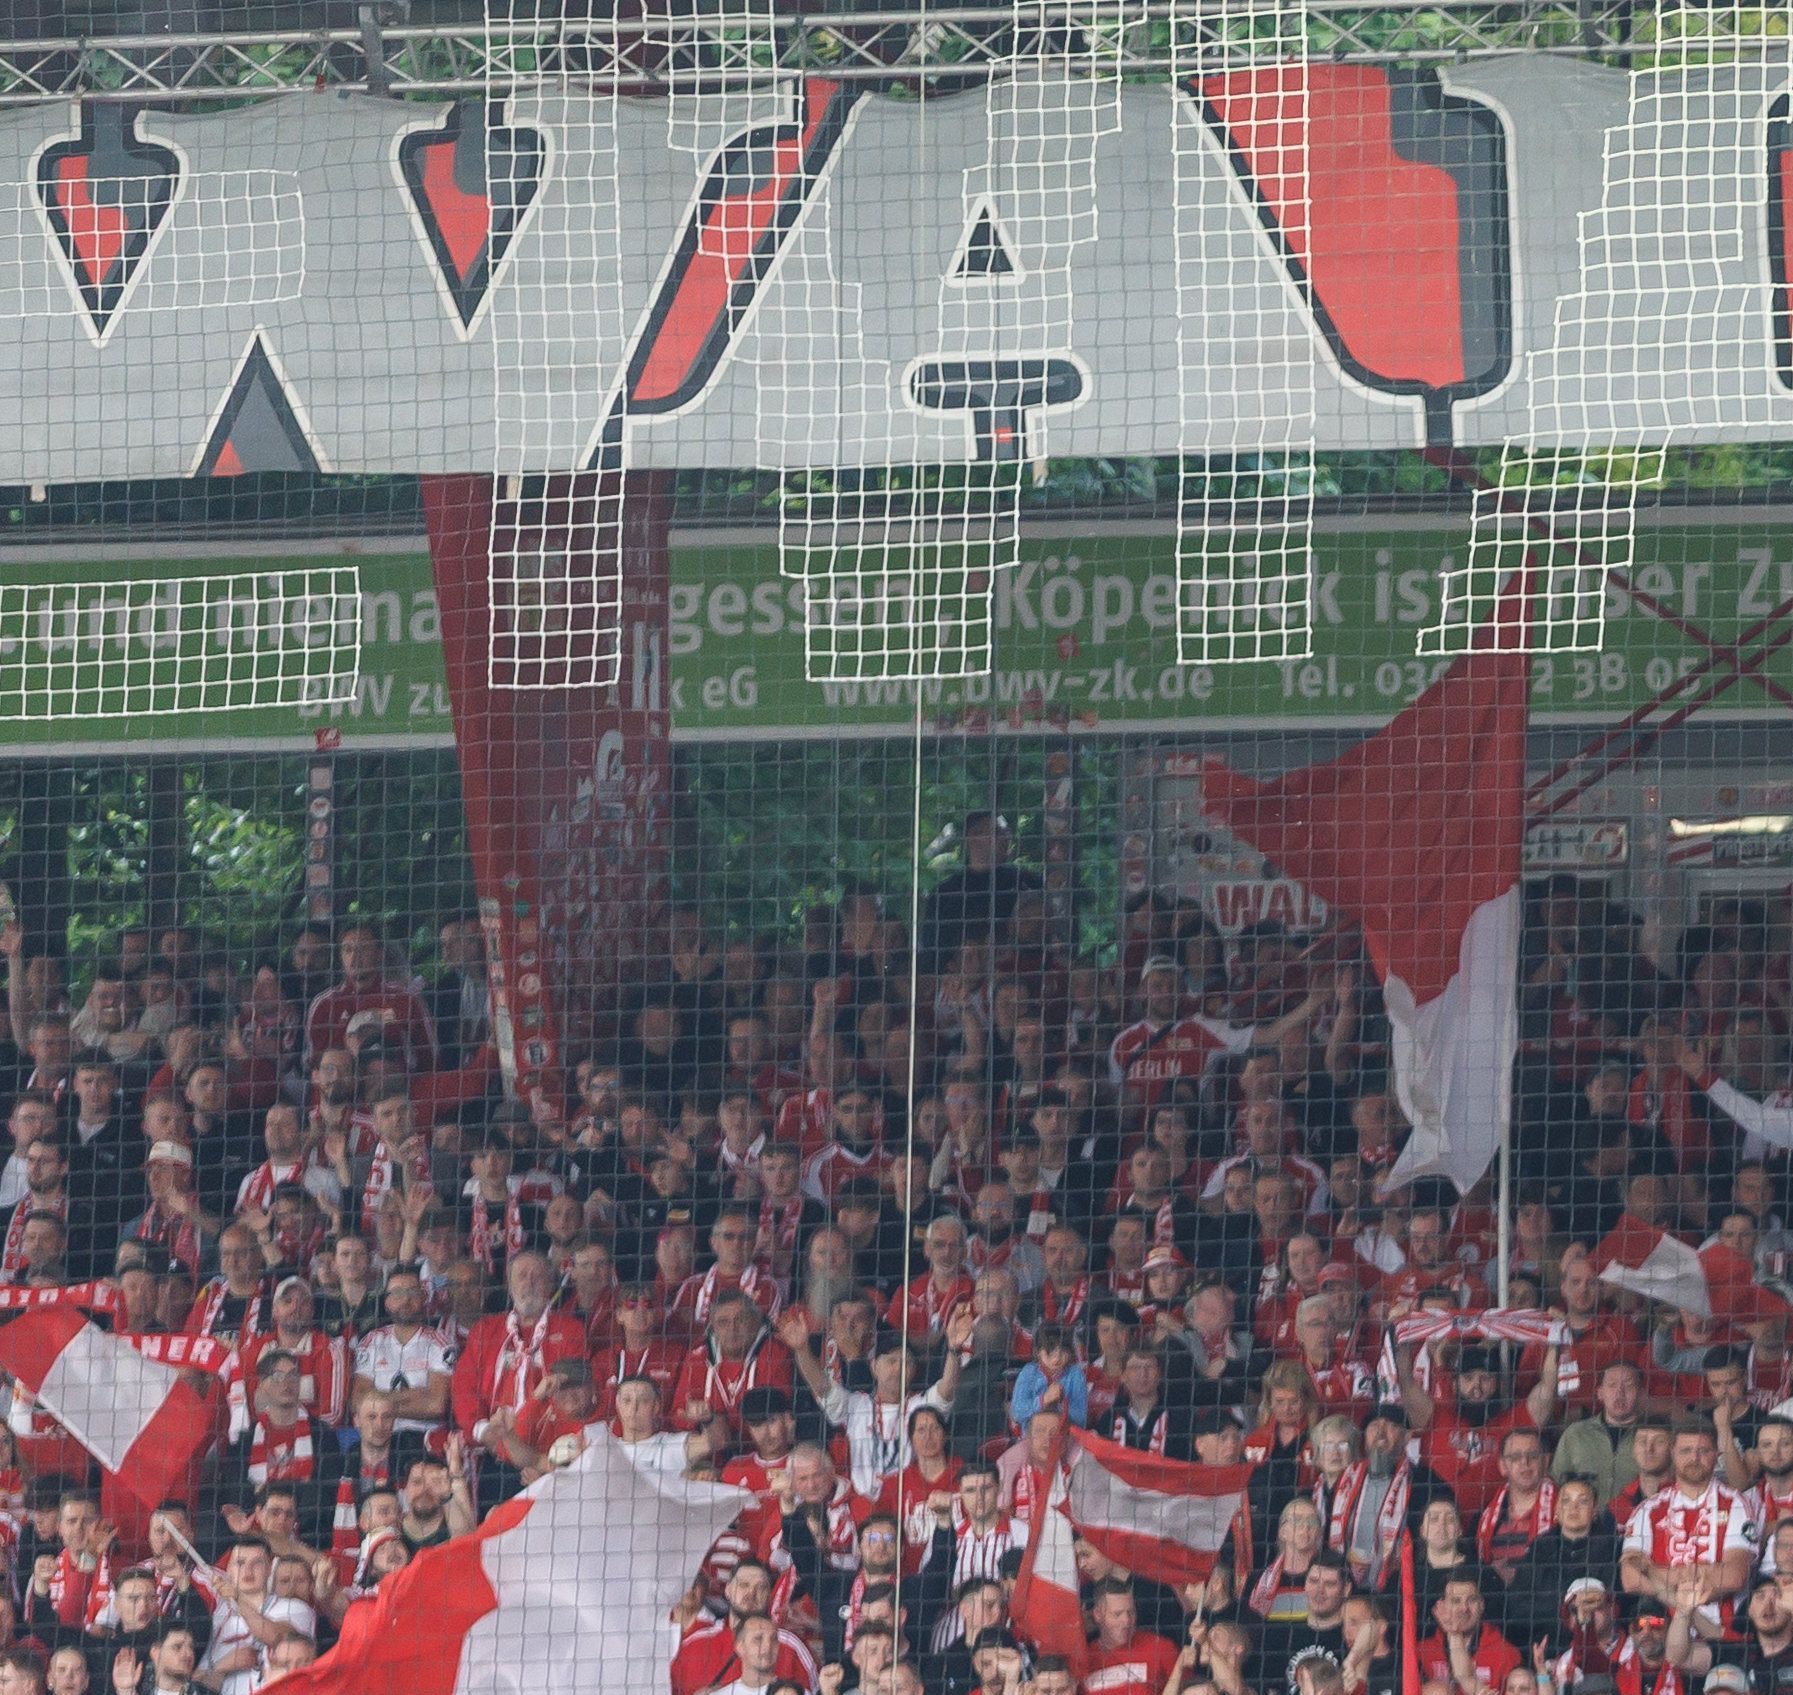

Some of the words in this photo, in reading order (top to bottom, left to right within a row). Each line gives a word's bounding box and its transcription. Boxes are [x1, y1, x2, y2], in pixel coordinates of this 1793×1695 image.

[212, 568, 442, 648] niema
[667, 572, 952, 655] gessen,
[1000, 555, 1347, 645] Köpenick
[300, 675, 393, 720] BWV
[702, 667, 758, 708] eG
[822, 658, 1214, 706] www.bwv-zk.de
[1282, 658, 1352, 702] Tel.
[1573, 655, 1628, 697] 38
[1645, 655, 1702, 697] 05
[1213, 880, 1326, 932] WAL
